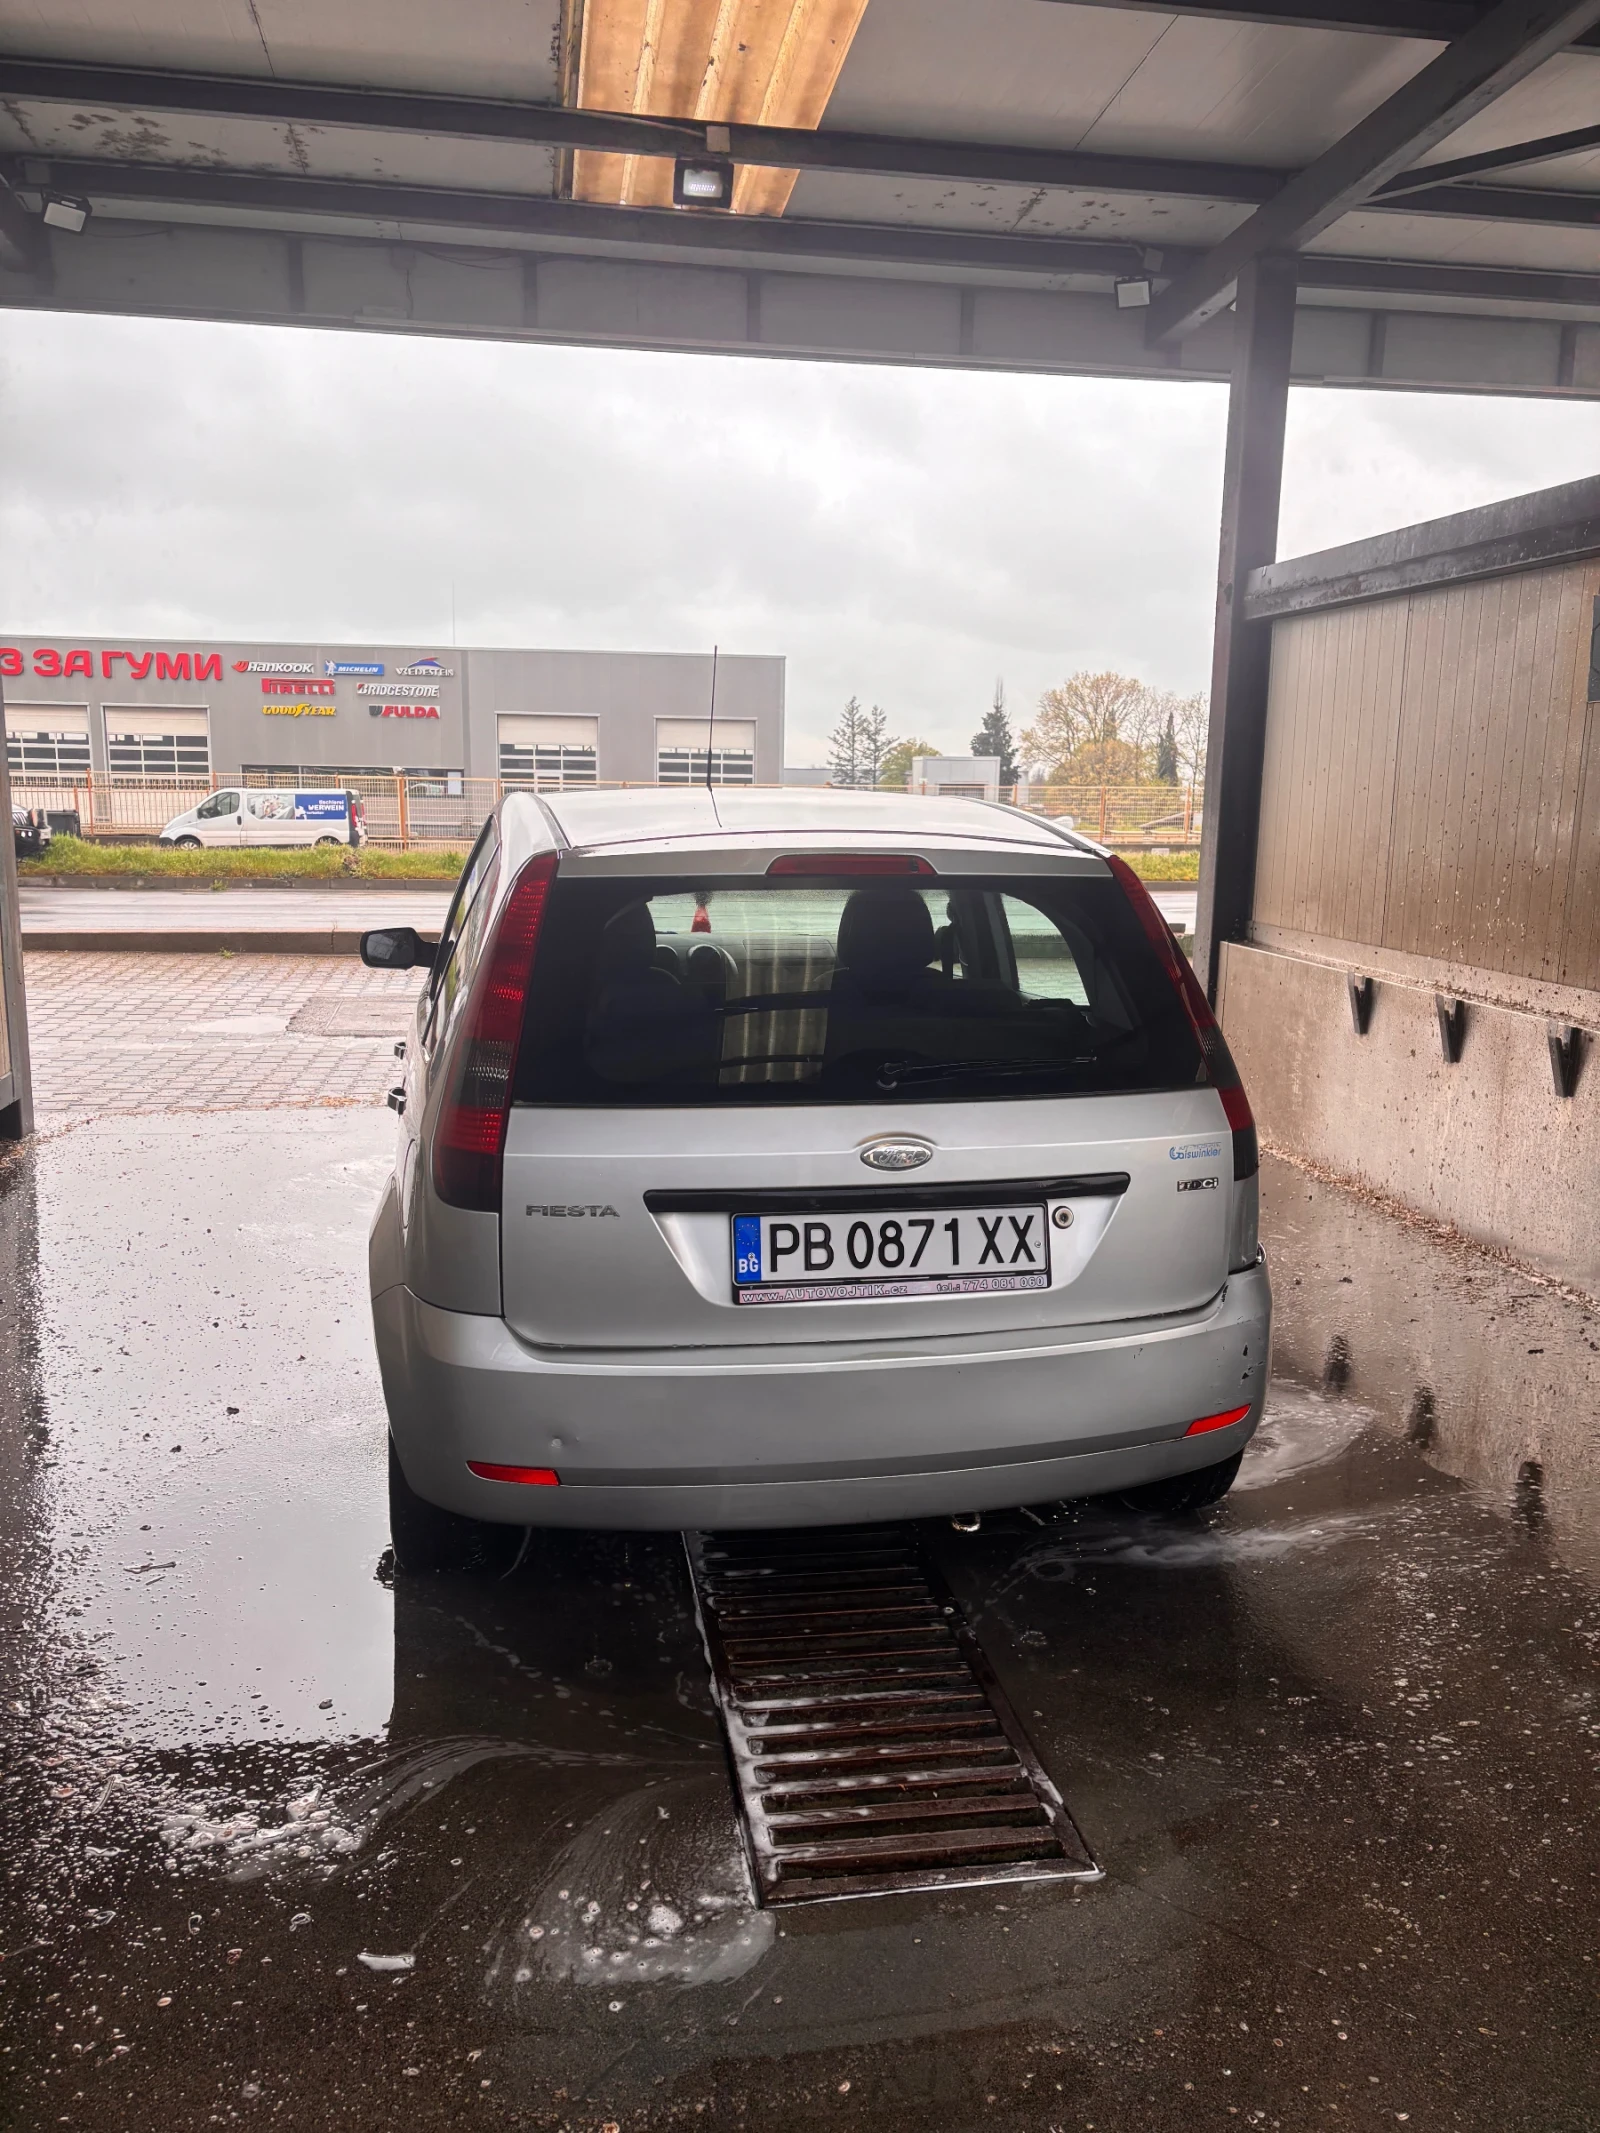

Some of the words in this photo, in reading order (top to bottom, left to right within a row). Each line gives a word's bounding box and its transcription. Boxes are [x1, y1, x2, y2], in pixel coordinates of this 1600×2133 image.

[33, 649, 93, 678] ЗА
[102, 650, 223, 681] ГУМИ
[395, 667, 455, 676] VREDESTEIN
[261, 678, 335, 695] PIRELLI
[357, 683, 440, 698] BRIDGESTONE
[381, 705, 440, 719] FULDA
[1178, 1177, 1218, 1192] TDCi
[526, 1204, 620, 1218] FIESTA
[769, 1222, 834, 1272] PB
[846, 1217, 960, 1270] 0871
[977, 1215, 1037, 1265] XX
[738, 1258, 759, 1274] BG
[742, 1284, 909, 1303] www.AUTOVOJTIK.cz
[962, 1279, 988, 1291] 774
